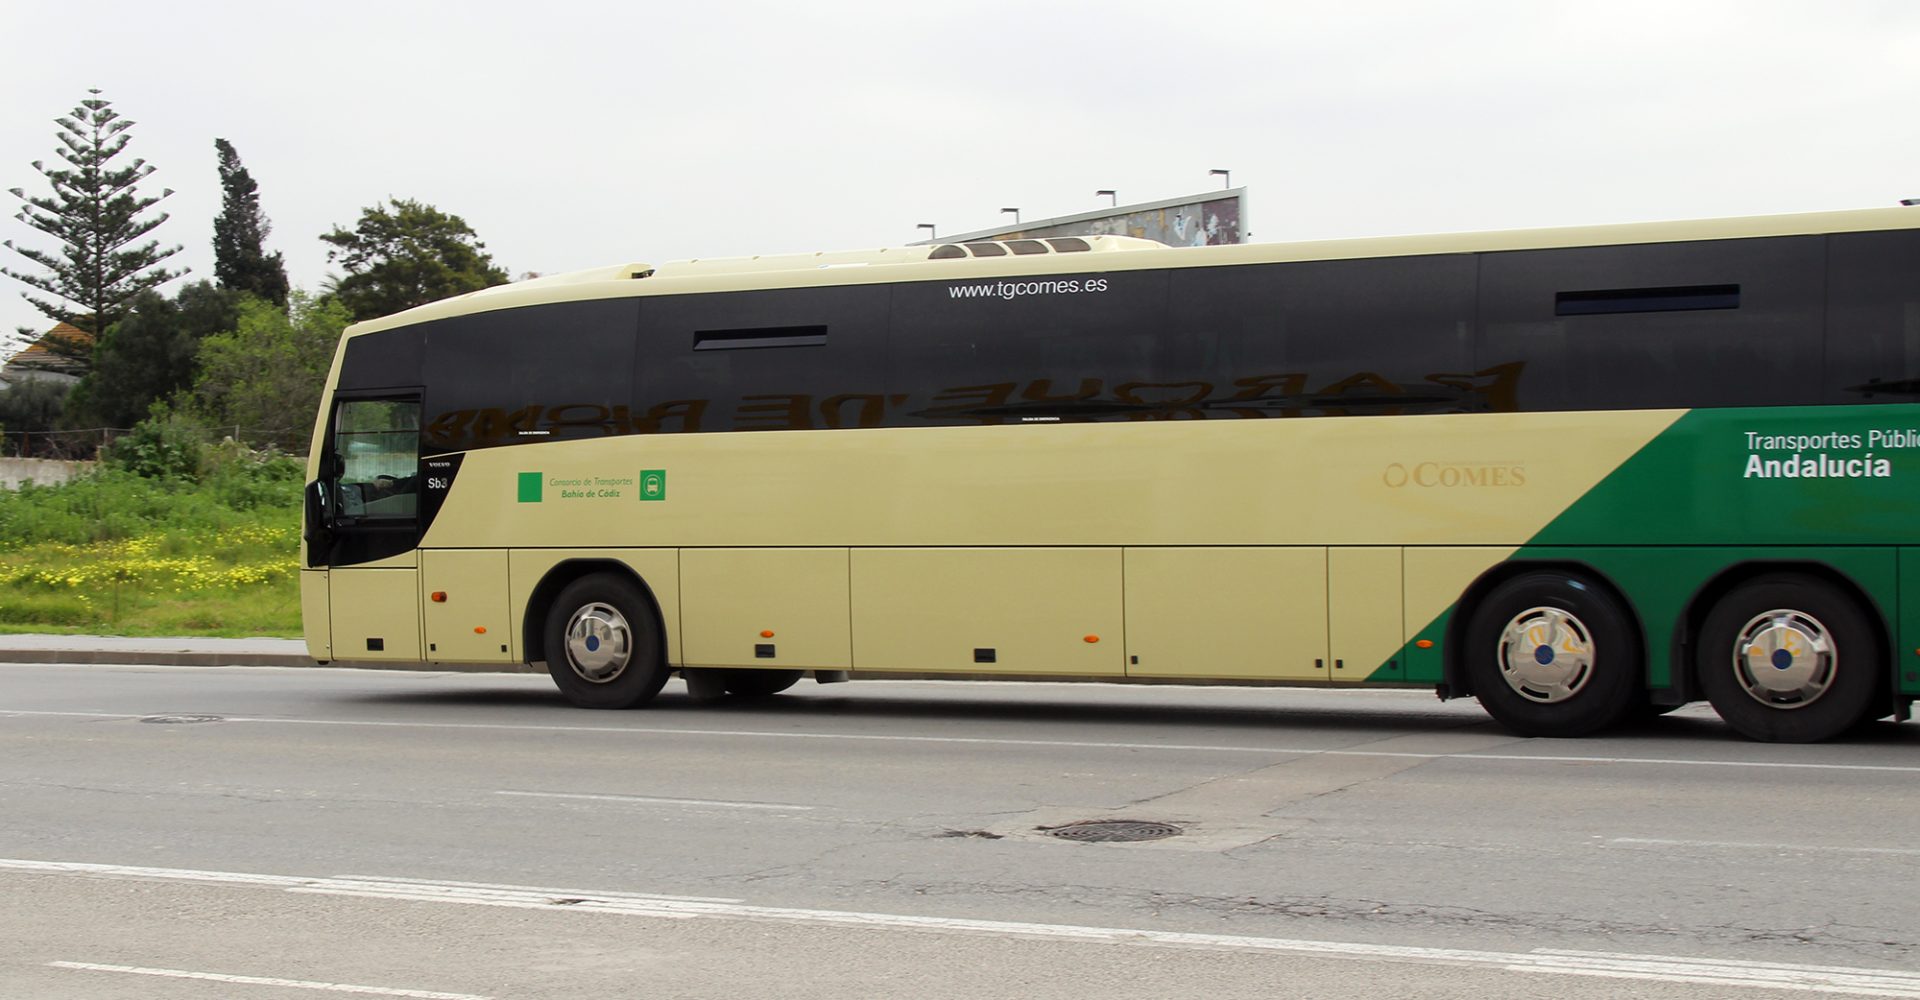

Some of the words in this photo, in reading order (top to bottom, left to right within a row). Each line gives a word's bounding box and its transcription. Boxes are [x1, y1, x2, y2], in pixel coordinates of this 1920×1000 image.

[949, 278, 1108, 300] www.tgcomes.es
[1744, 431, 1862, 452] Transportes
[1868, 429, 1920, 448] Públi
[1413, 461, 1526, 488] COMES
[1743, 453, 1891, 478] Andalucía
[549, 478, 581, 486] Consorcio
[583, 478, 592, 486] de
[594, 477, 633, 486] Transportes
[586, 490, 596, 498] de
